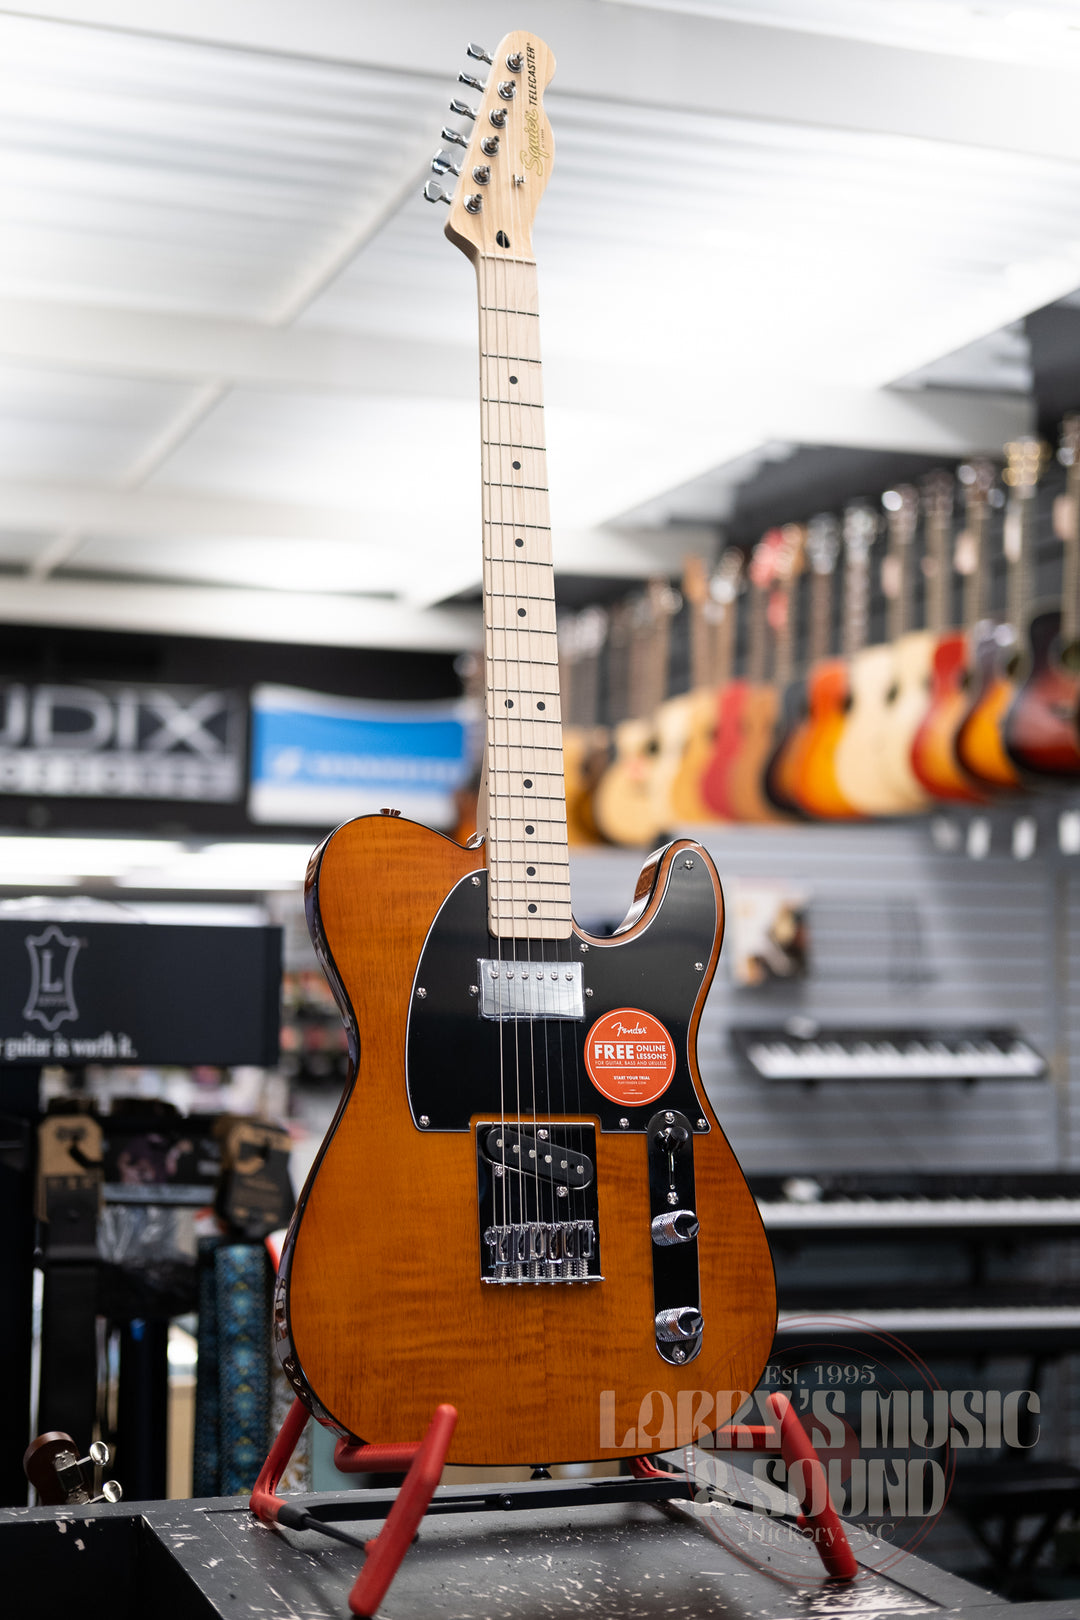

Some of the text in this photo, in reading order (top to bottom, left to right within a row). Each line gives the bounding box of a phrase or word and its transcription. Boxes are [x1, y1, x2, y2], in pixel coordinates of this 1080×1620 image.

[520, 46, 550, 176] Squier TELECASTER
[611, 1022, 648, 1037] Fender
[594, 1044, 634, 1059] FREE
